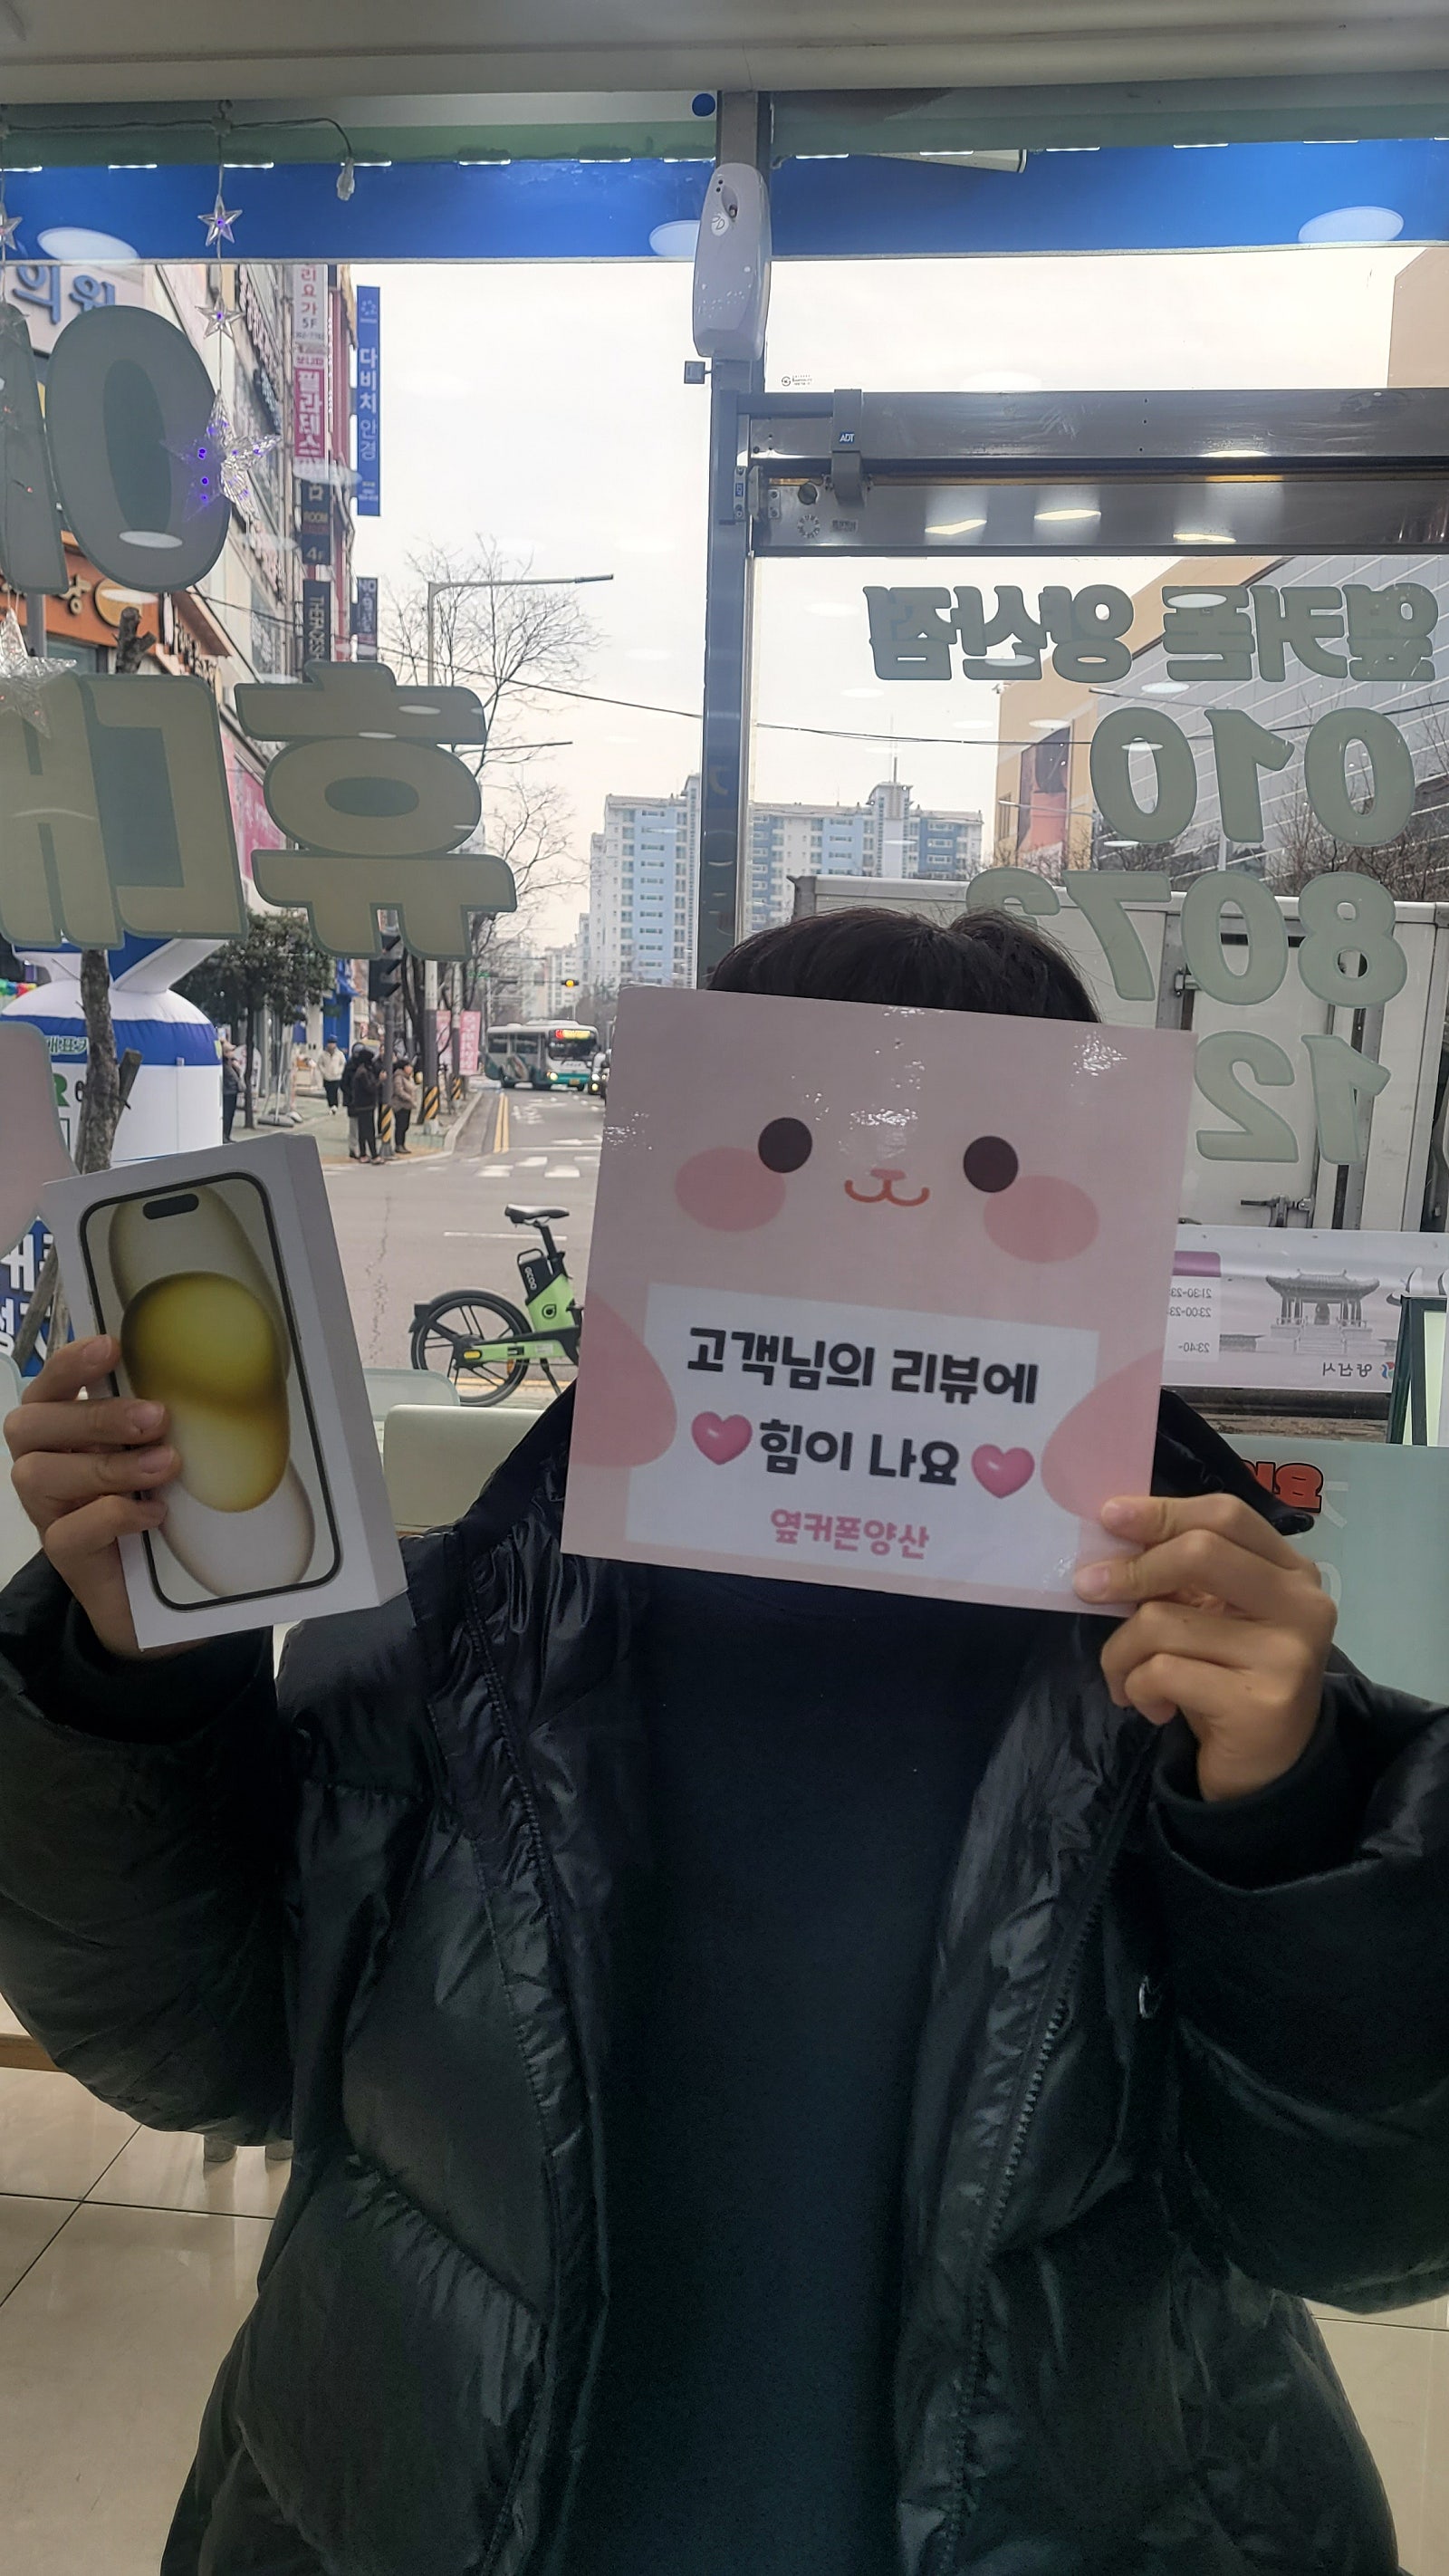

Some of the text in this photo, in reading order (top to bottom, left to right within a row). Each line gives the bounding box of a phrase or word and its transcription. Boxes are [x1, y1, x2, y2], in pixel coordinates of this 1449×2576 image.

[359, 346, 379, 462] 다비치안경
[840, 433, 855, 443] ADT
[686, 1327, 1039, 1405] 고객님의 리뷰에
[759, 1418, 960, 1486] 힘이 나요
[770, 1507, 930, 1560] 옆커폰양산
